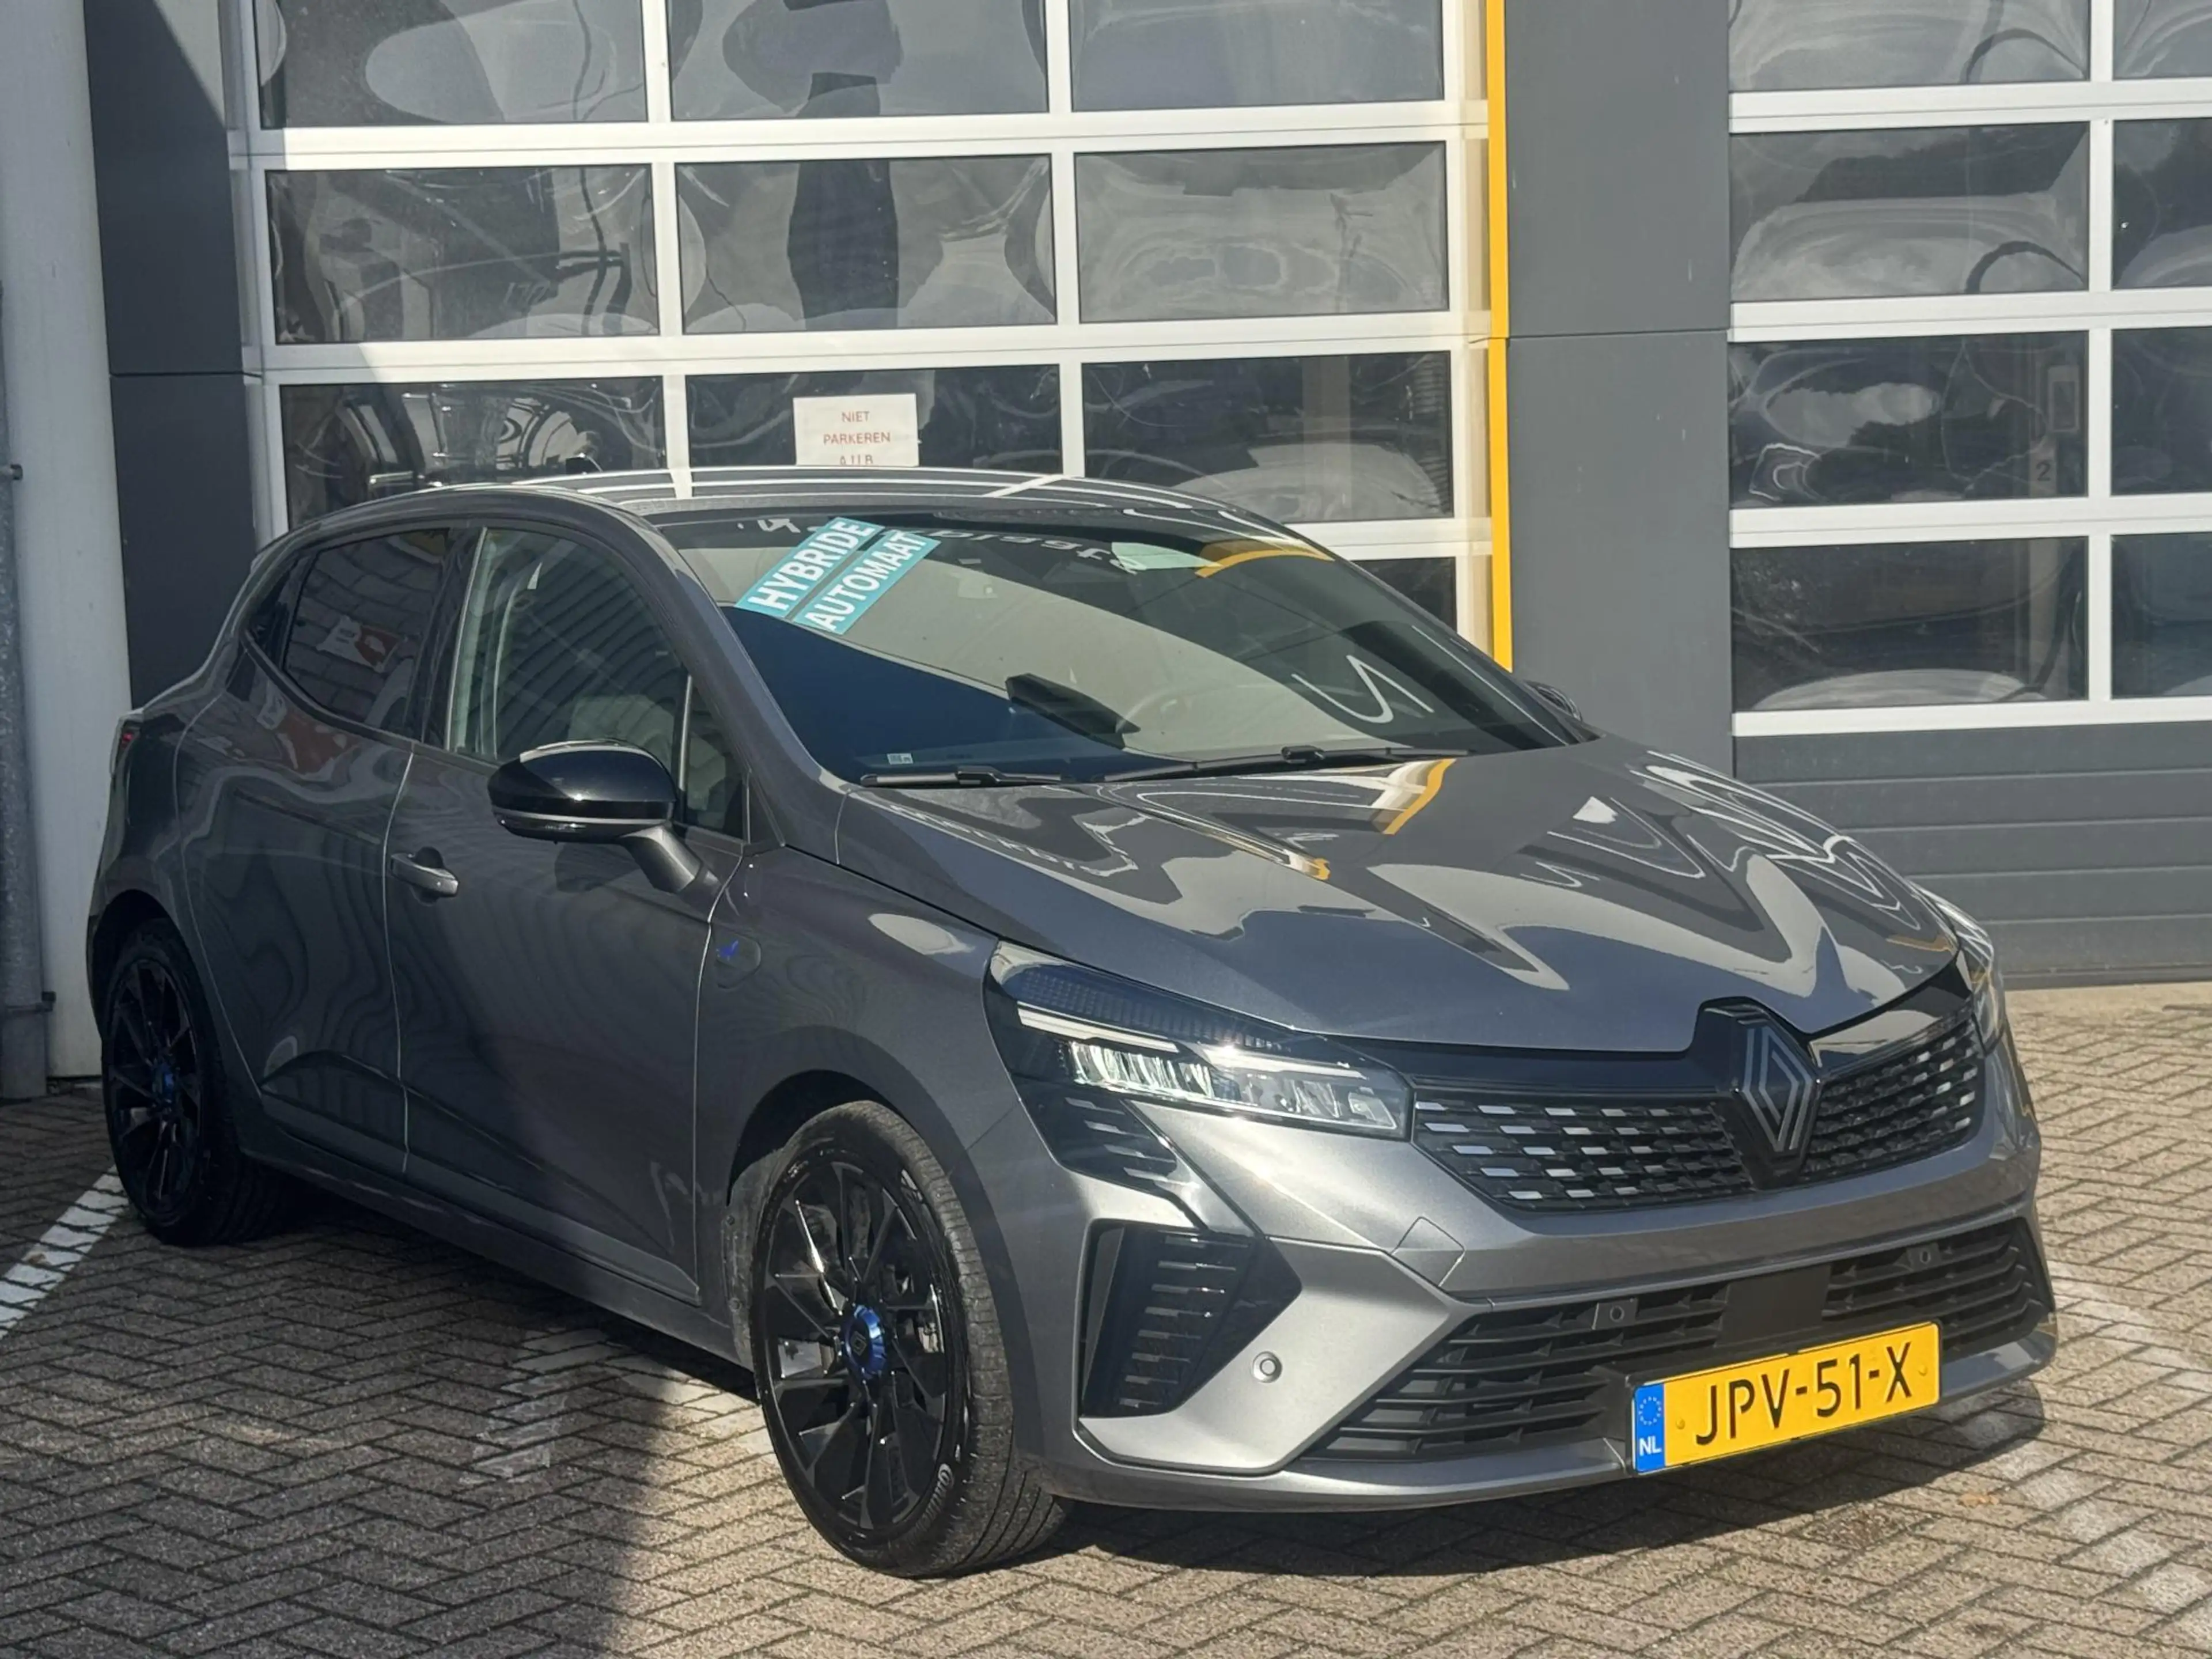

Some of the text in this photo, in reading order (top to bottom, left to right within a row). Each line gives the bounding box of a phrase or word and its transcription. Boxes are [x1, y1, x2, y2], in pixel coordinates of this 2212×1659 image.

[841, 411, 870, 423] NIET
[823, 431, 891, 445] PARKEREN
[2035, 460, 2051, 482] 2
[747, 521, 876, 611] HYBRIDE
[804, 529, 927, 632] AUTOMAAT
[1695, 1341, 1912, 1445] JPV-51-X
[1639, 1435, 1662, 1456] NL
